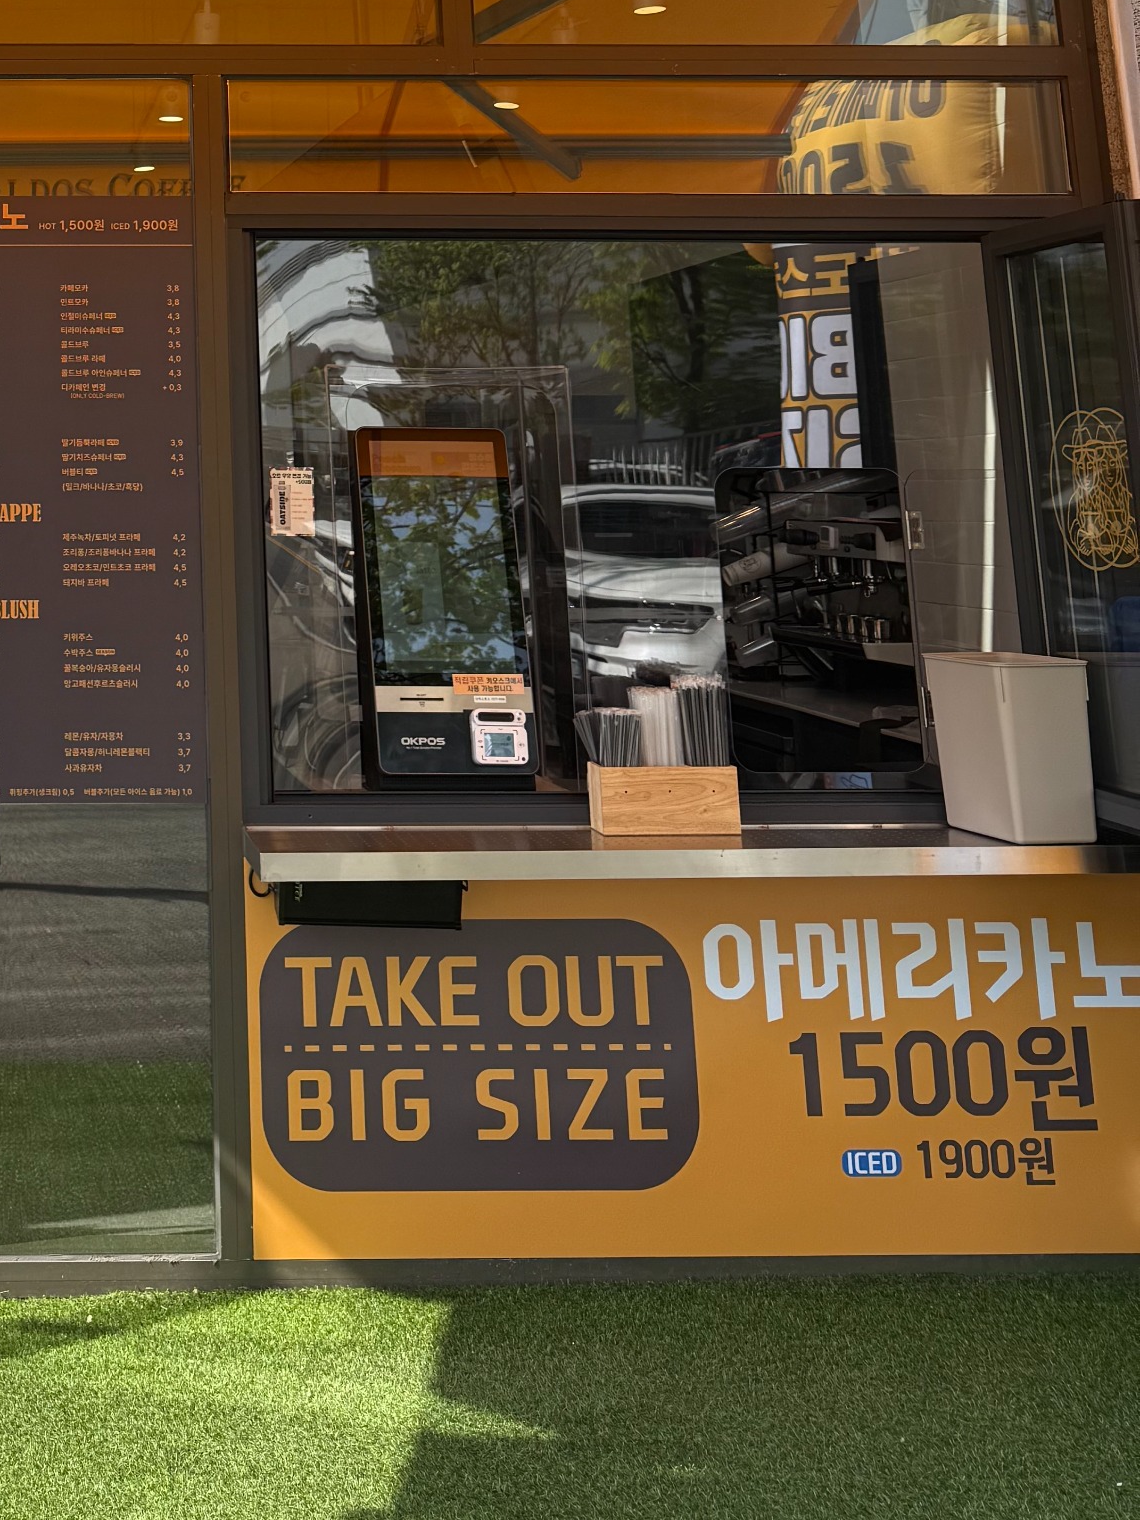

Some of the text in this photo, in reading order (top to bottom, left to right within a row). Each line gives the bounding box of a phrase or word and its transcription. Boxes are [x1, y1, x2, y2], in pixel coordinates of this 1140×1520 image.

[38, 222, 56, 231] HOT
[59, 218, 105, 233] 1,500원
[110, 222, 130, 231] ICED
[133, 218, 178, 233] 1,900원
[63, 649, 93, 657] 수박주스
[401, 737, 446, 746] OKPOS
[284, 954, 664, 1028] TAKE OUT
[702, 917, 1140, 1022] 아메리카노
[287, 1068, 669, 1142] BIG SIZE
[788, 1025, 1100, 1131] 1500원
[845, 1137, 1056, 1186] ICED 1900원
